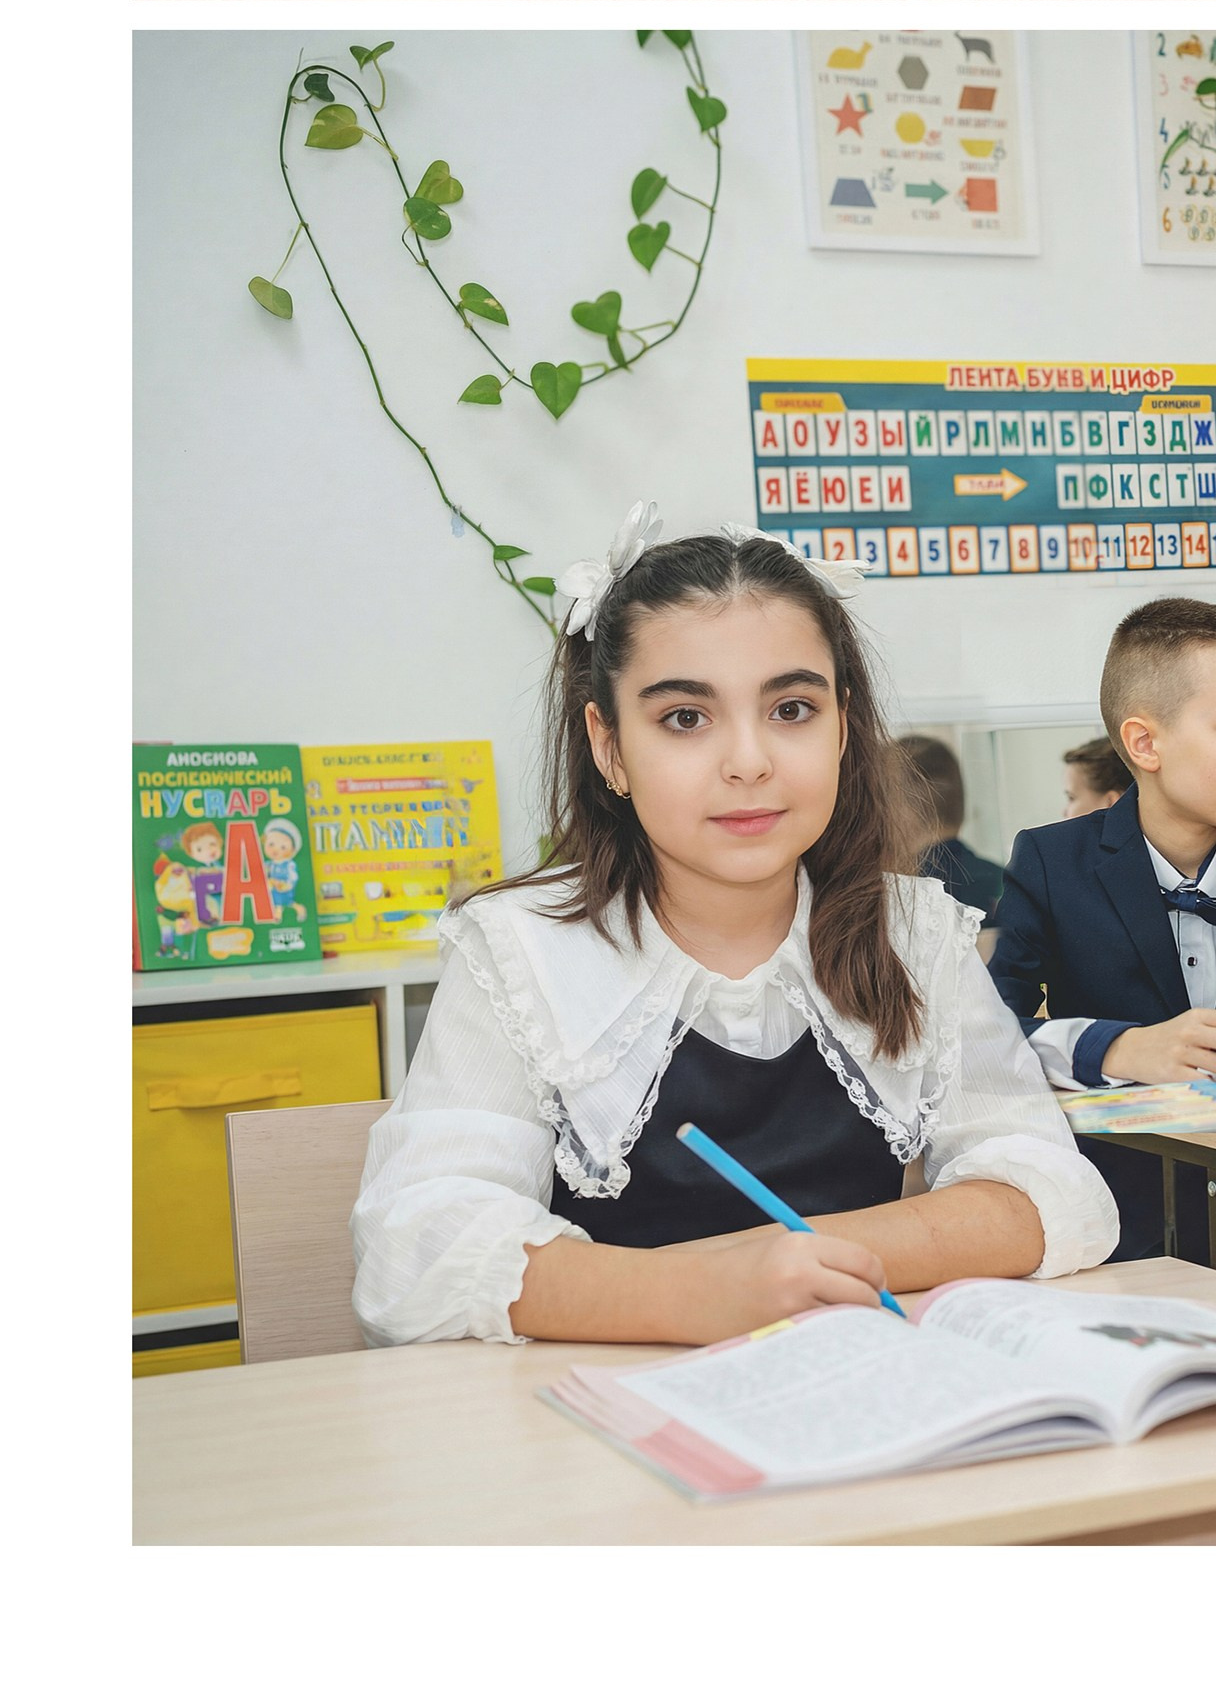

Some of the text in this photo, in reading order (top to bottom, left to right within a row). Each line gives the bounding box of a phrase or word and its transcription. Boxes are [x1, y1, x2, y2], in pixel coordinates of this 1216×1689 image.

[949, 367, 1019, 388] ЛЕНТА
[1091, 369, 1104, 388] И
[1111, 369, 1174, 392] ЦИФР
[832, 541, 844, 560] 2
[866, 541, 877, 563] 3
[897, 540, 909, 561] 4
[929, 540, 940, 561] 5
[958, 539, 969, 560] 6
[989, 539, 999, 560] 7
[1019, 538, 1030, 559] 8
[1047, 538, 1059, 559] 9
[1102, 536, 1121, 558] 11
[1130, 535, 1150, 557] 12
[1157, 535, 1177, 556] 13
[1185, 534, 1206, 555] 14
[222, 820, 276, 924] А
